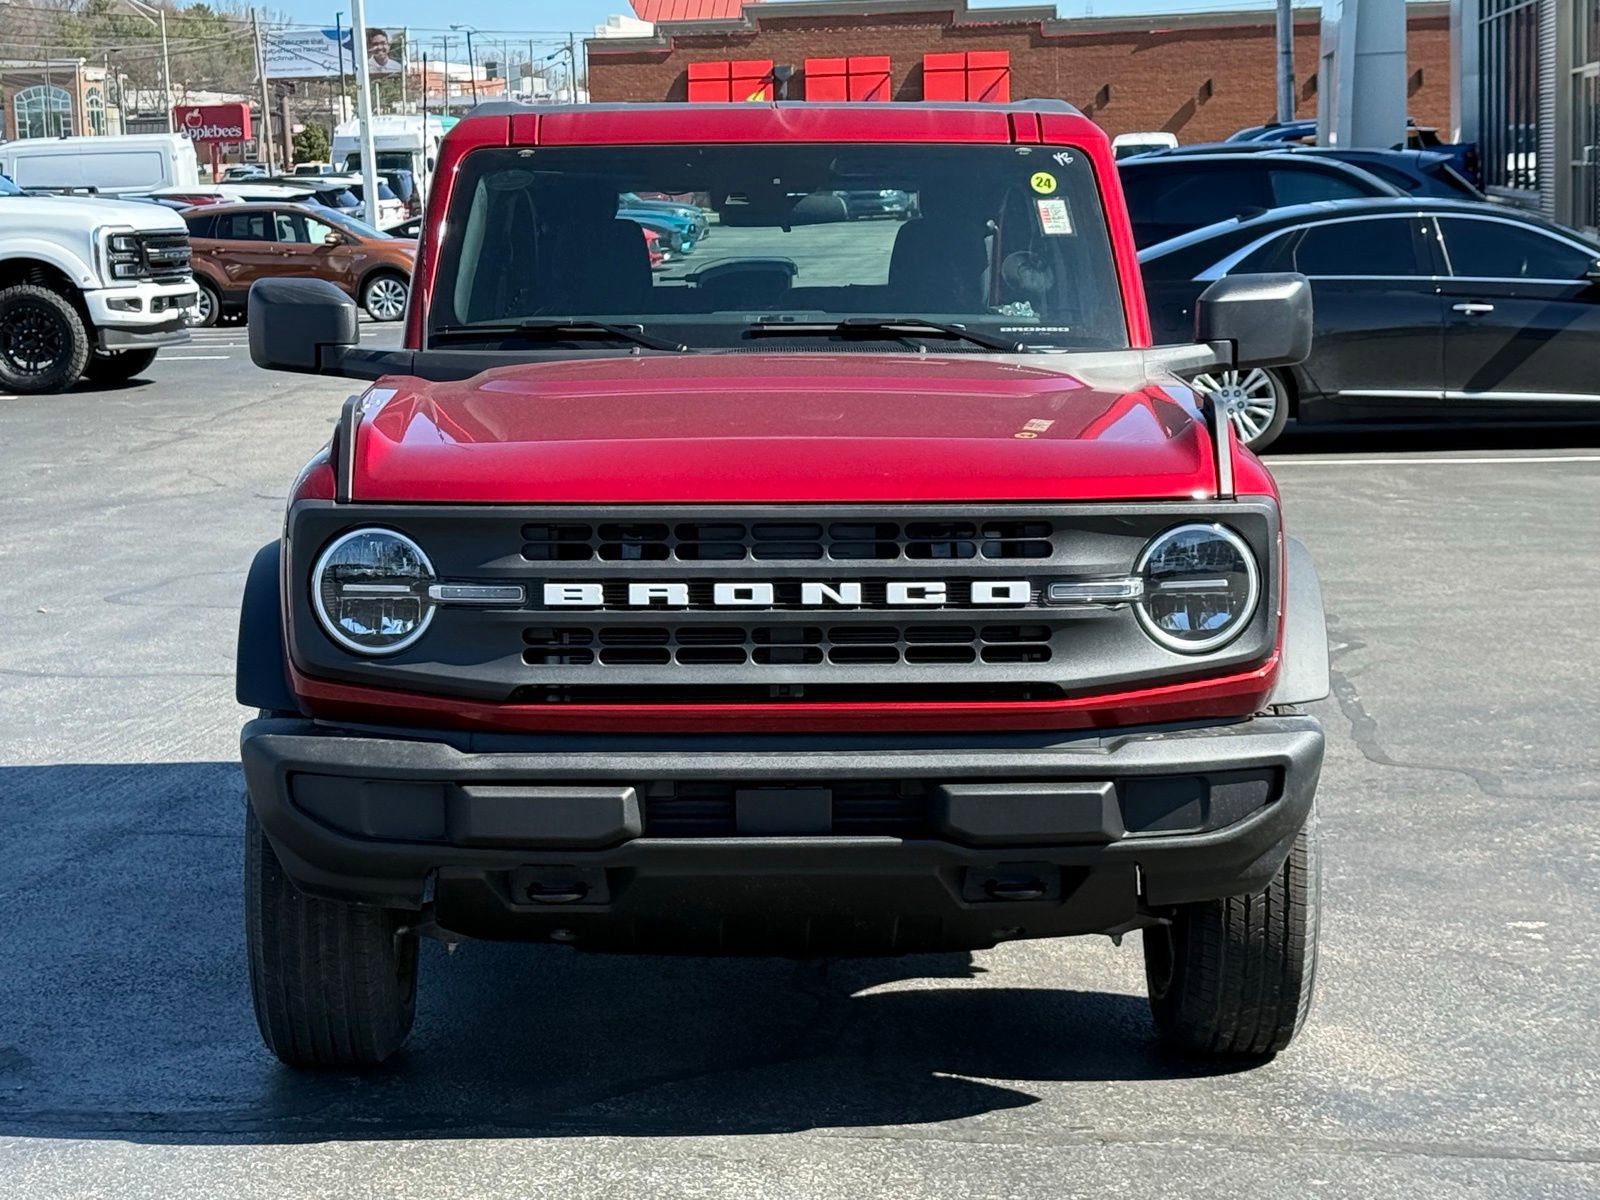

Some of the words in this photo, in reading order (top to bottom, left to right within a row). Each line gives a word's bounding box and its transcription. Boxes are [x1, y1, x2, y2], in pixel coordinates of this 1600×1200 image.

[180, 123, 242, 140] Applebee's
[1035, 176, 1052, 189] 24
[543, 580, 1032, 607] BRONCO
